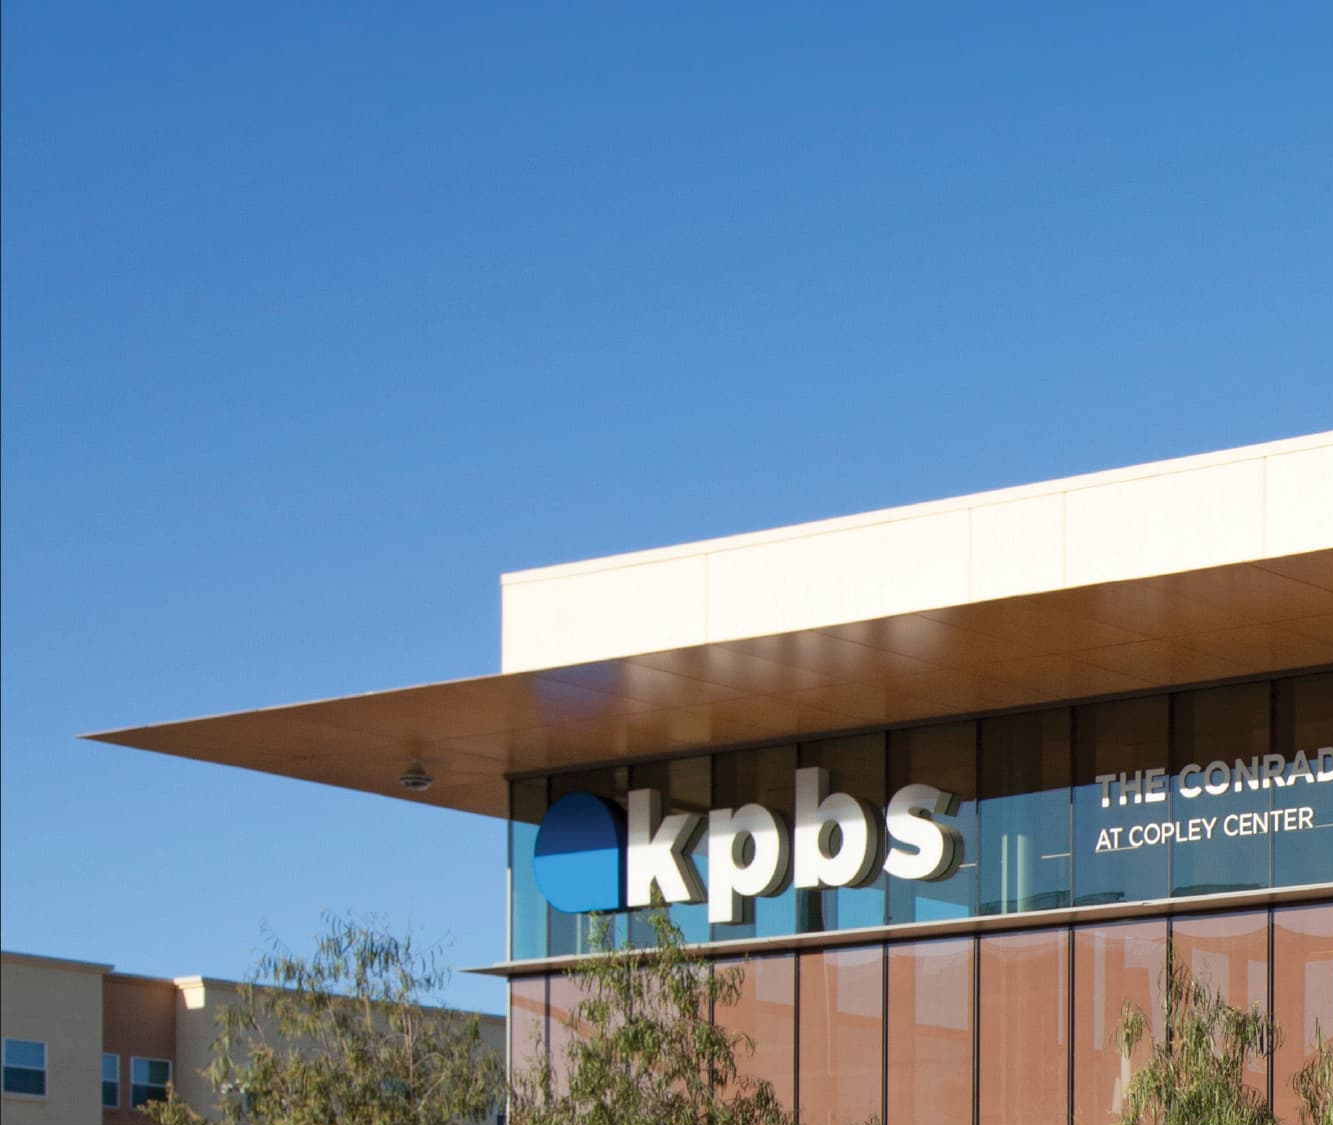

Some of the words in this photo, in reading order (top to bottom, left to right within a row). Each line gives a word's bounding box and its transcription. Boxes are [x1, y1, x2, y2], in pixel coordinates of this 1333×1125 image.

[1095, 767, 1167, 808] THE
[626, 767, 962, 924] kpbs
[1095, 827, 1123, 851] AT
[1128, 817, 1217, 847] COPLEY
[1223, 806, 1315, 836] CENTER
